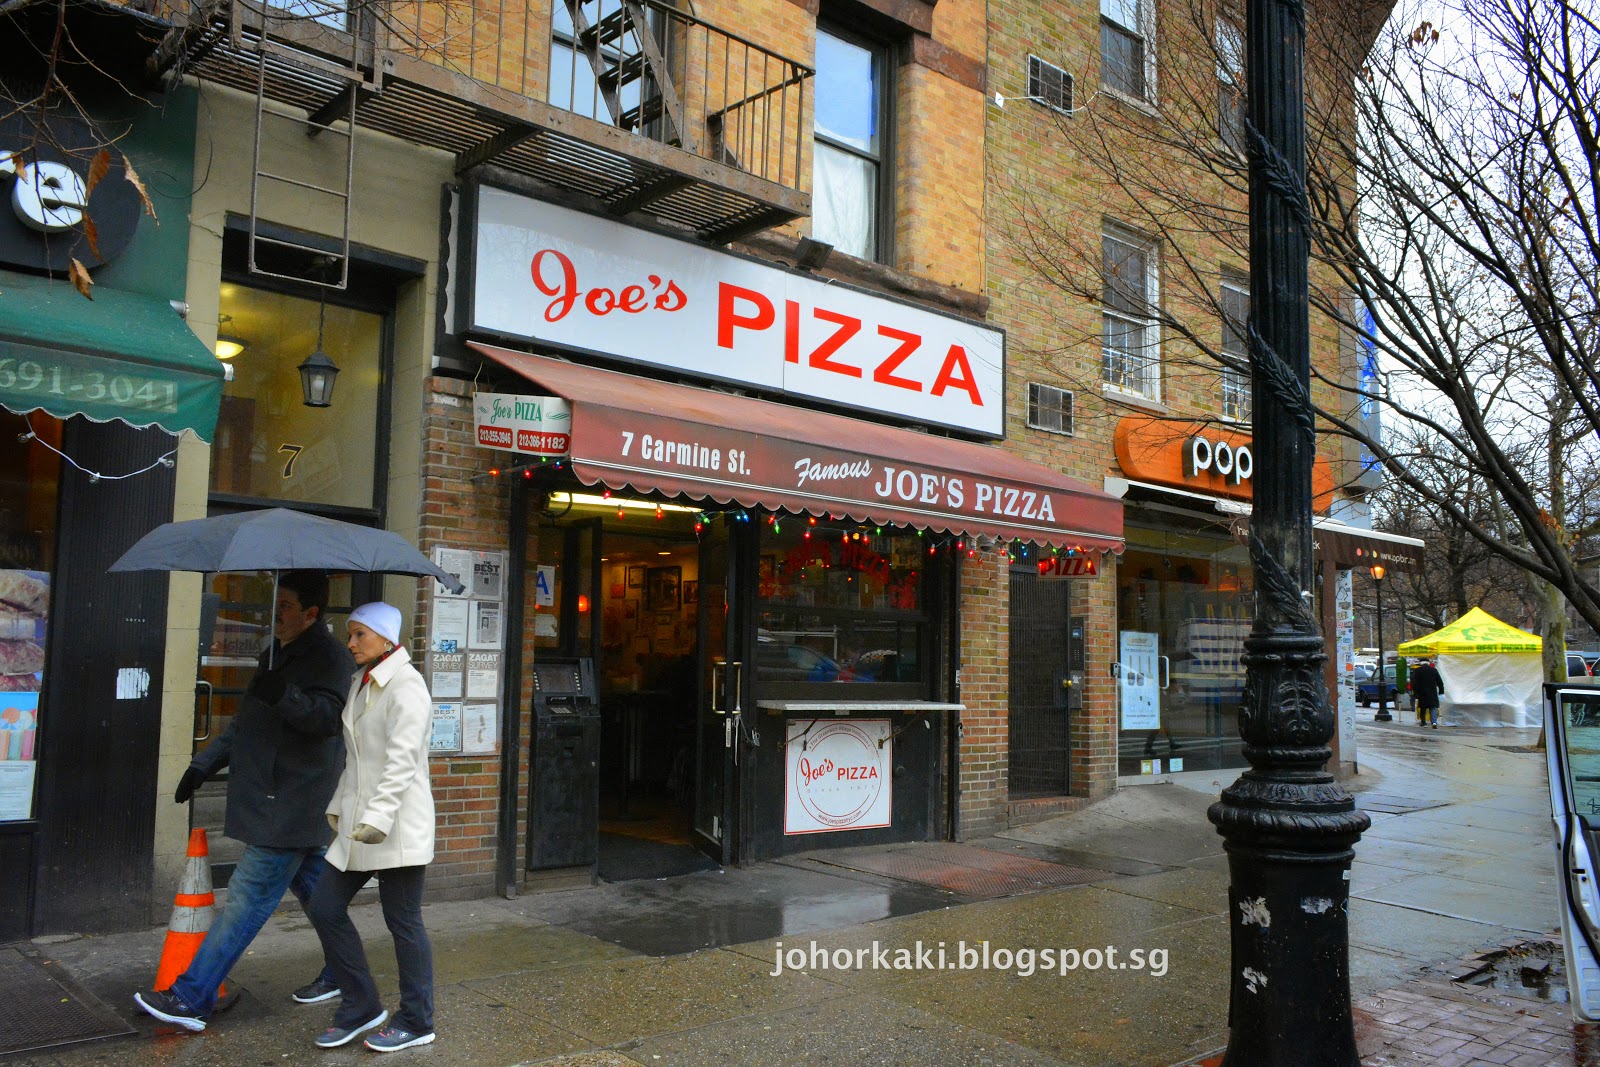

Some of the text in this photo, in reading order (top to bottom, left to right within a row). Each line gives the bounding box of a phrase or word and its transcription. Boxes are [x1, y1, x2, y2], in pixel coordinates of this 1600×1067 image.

[530, 249, 984, 407] Joe's PIZZA
[490, 398, 542, 424] Joe's PIZZA
[518, 433, 565, 450] 212-366-1182
[277, 443, 304, 479] 7
[1192, 435, 1253, 485] pop
[621, 431, 1056, 522] 7 Carmine St. Famous JOE'S PIZZA
[473, 564, 500, 573] BEST
[1038, 558, 1097, 576] PIZZA
[536, 571, 549, 595] A
[1476, 644, 1498, 652] BEST
[1501, 644, 1537, 652] PICKLES
[432, 661, 462, 670] SURVEY
[433, 654, 463, 662] ZAGAT
[468, 653, 498, 662] ZAGAT
[468, 661, 498, 669] SURVEY
[800, 757, 878, 787] Joe's PIZZA
